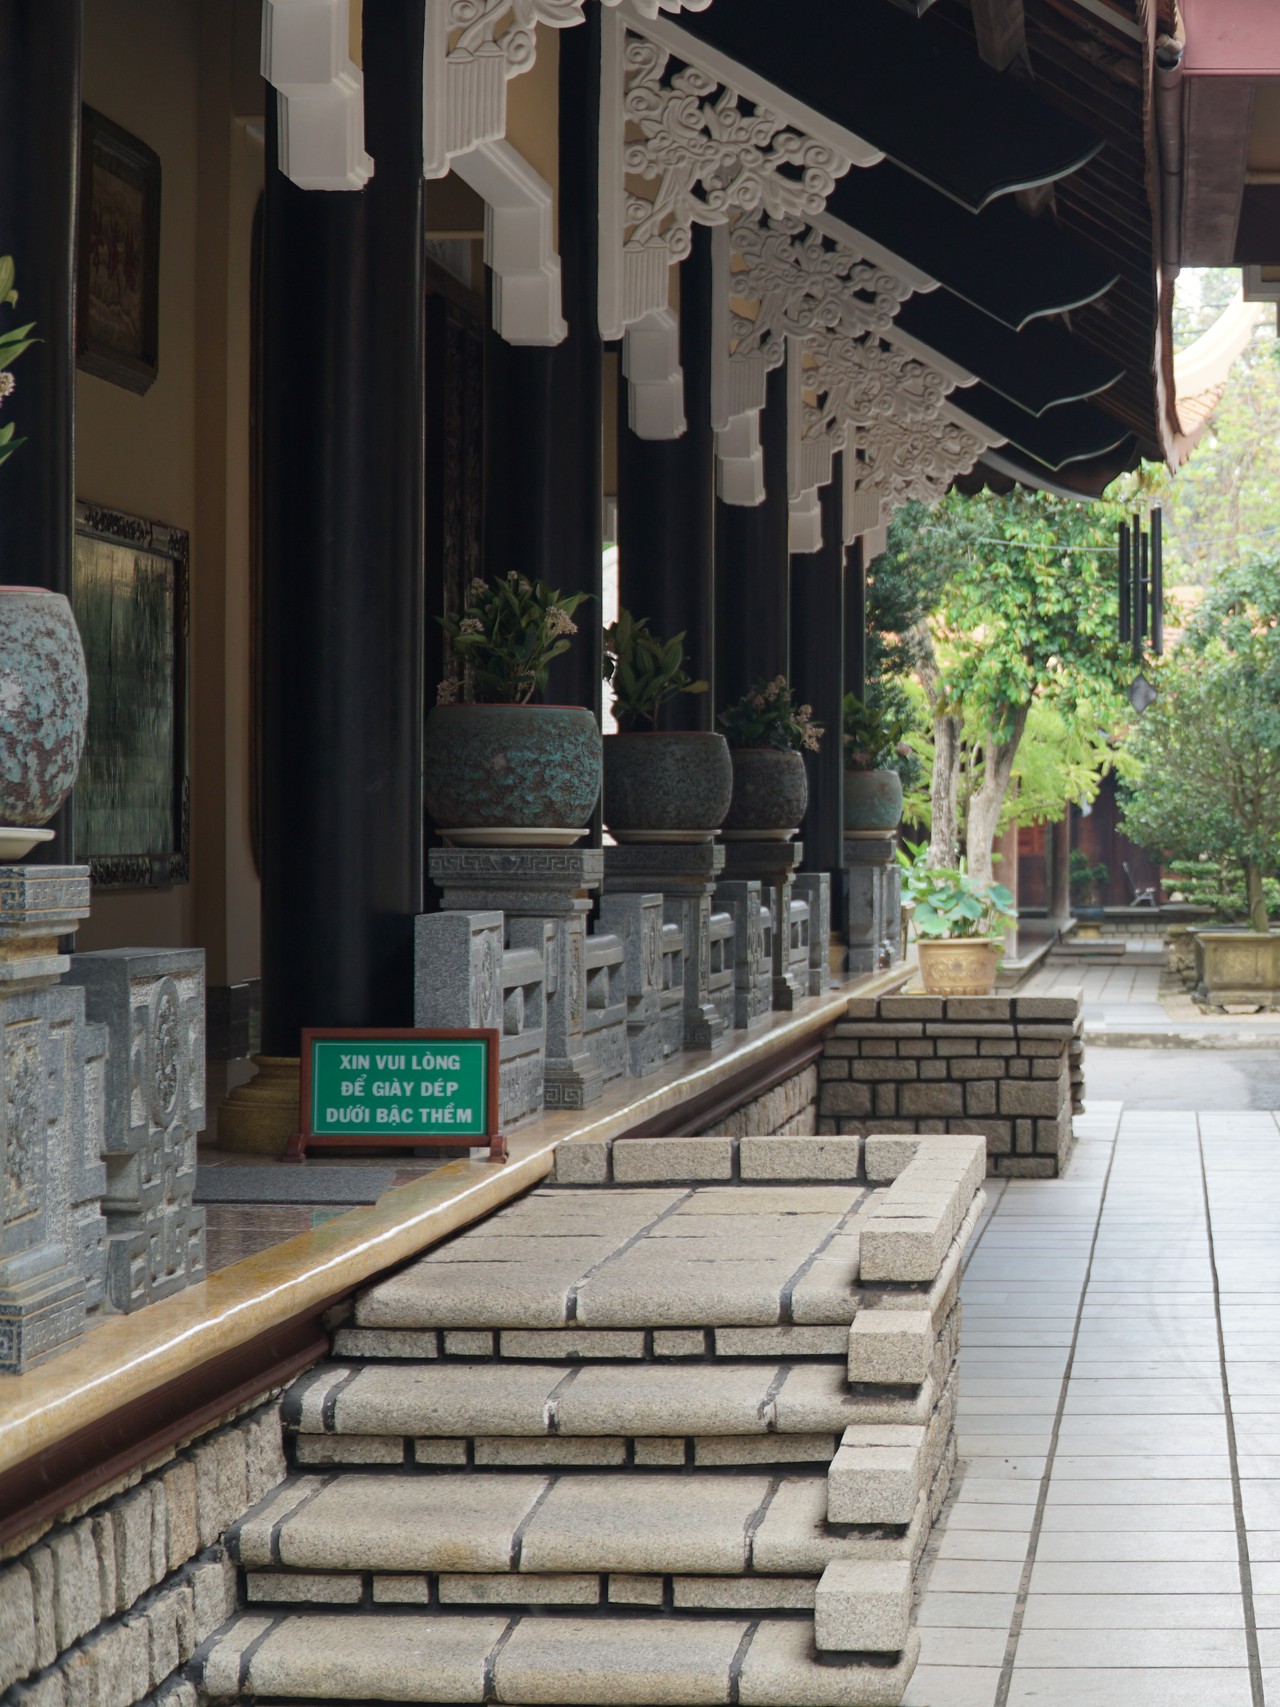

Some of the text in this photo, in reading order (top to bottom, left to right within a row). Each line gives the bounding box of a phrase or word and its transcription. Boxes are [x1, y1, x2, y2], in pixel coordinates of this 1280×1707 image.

[340, 1052, 461, 1070] XIN VUI LÒNG
[340, 1074, 459, 1096] ĐỂ GIÀY DÉP
[326, 1102, 472, 1126] DƯỚI BẬC THỀM
